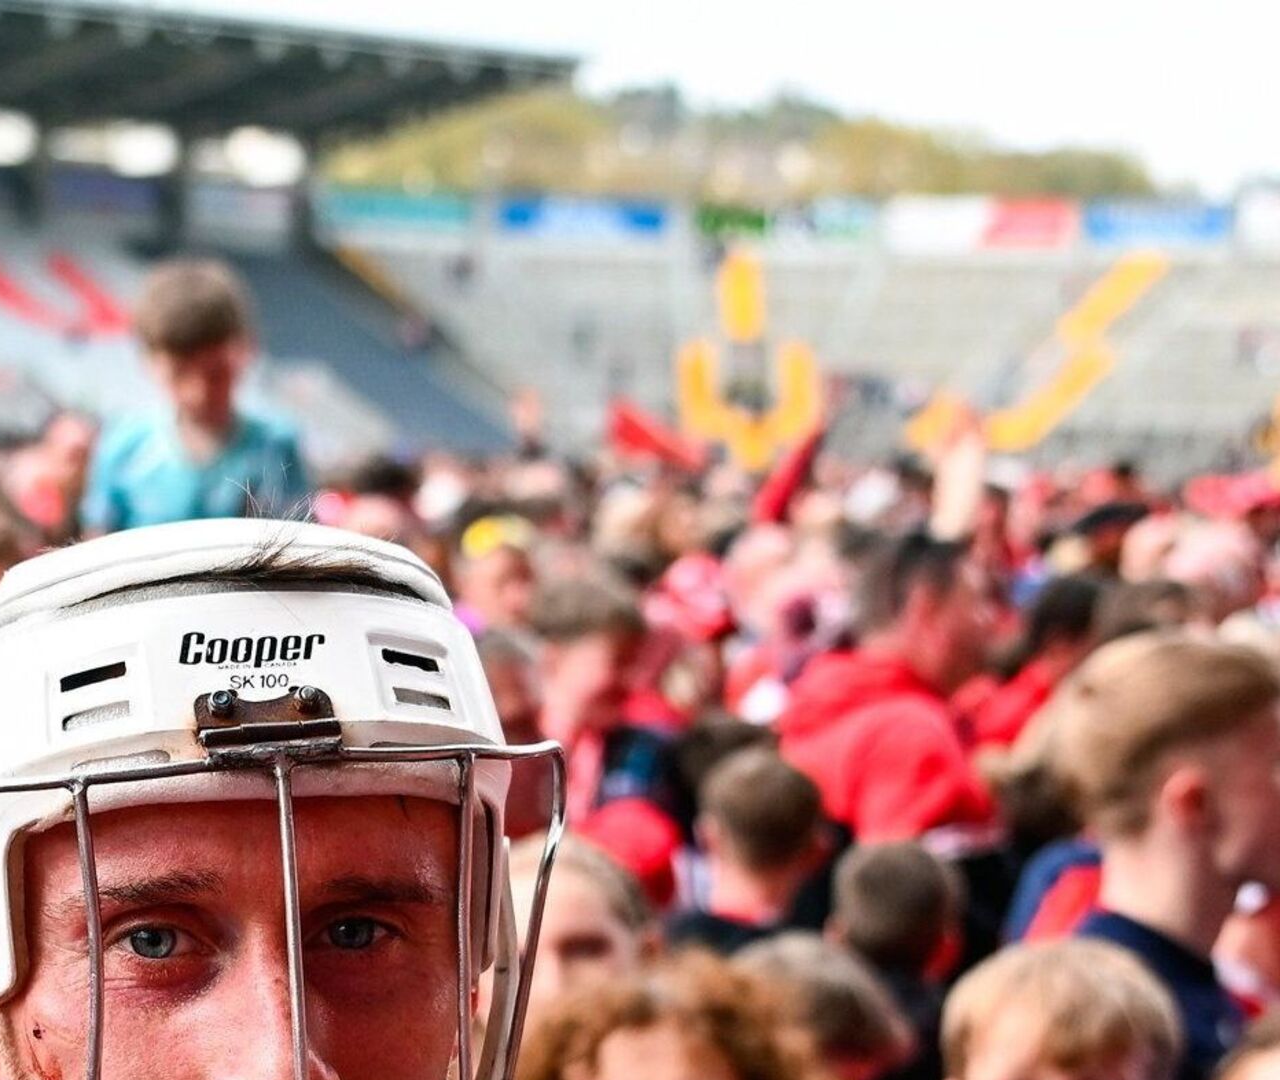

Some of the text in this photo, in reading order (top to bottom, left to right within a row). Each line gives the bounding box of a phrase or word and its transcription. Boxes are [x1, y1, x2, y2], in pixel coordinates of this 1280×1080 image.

[178, 631, 326, 668] Cooper
[230, 673, 289, 689] SK 100
